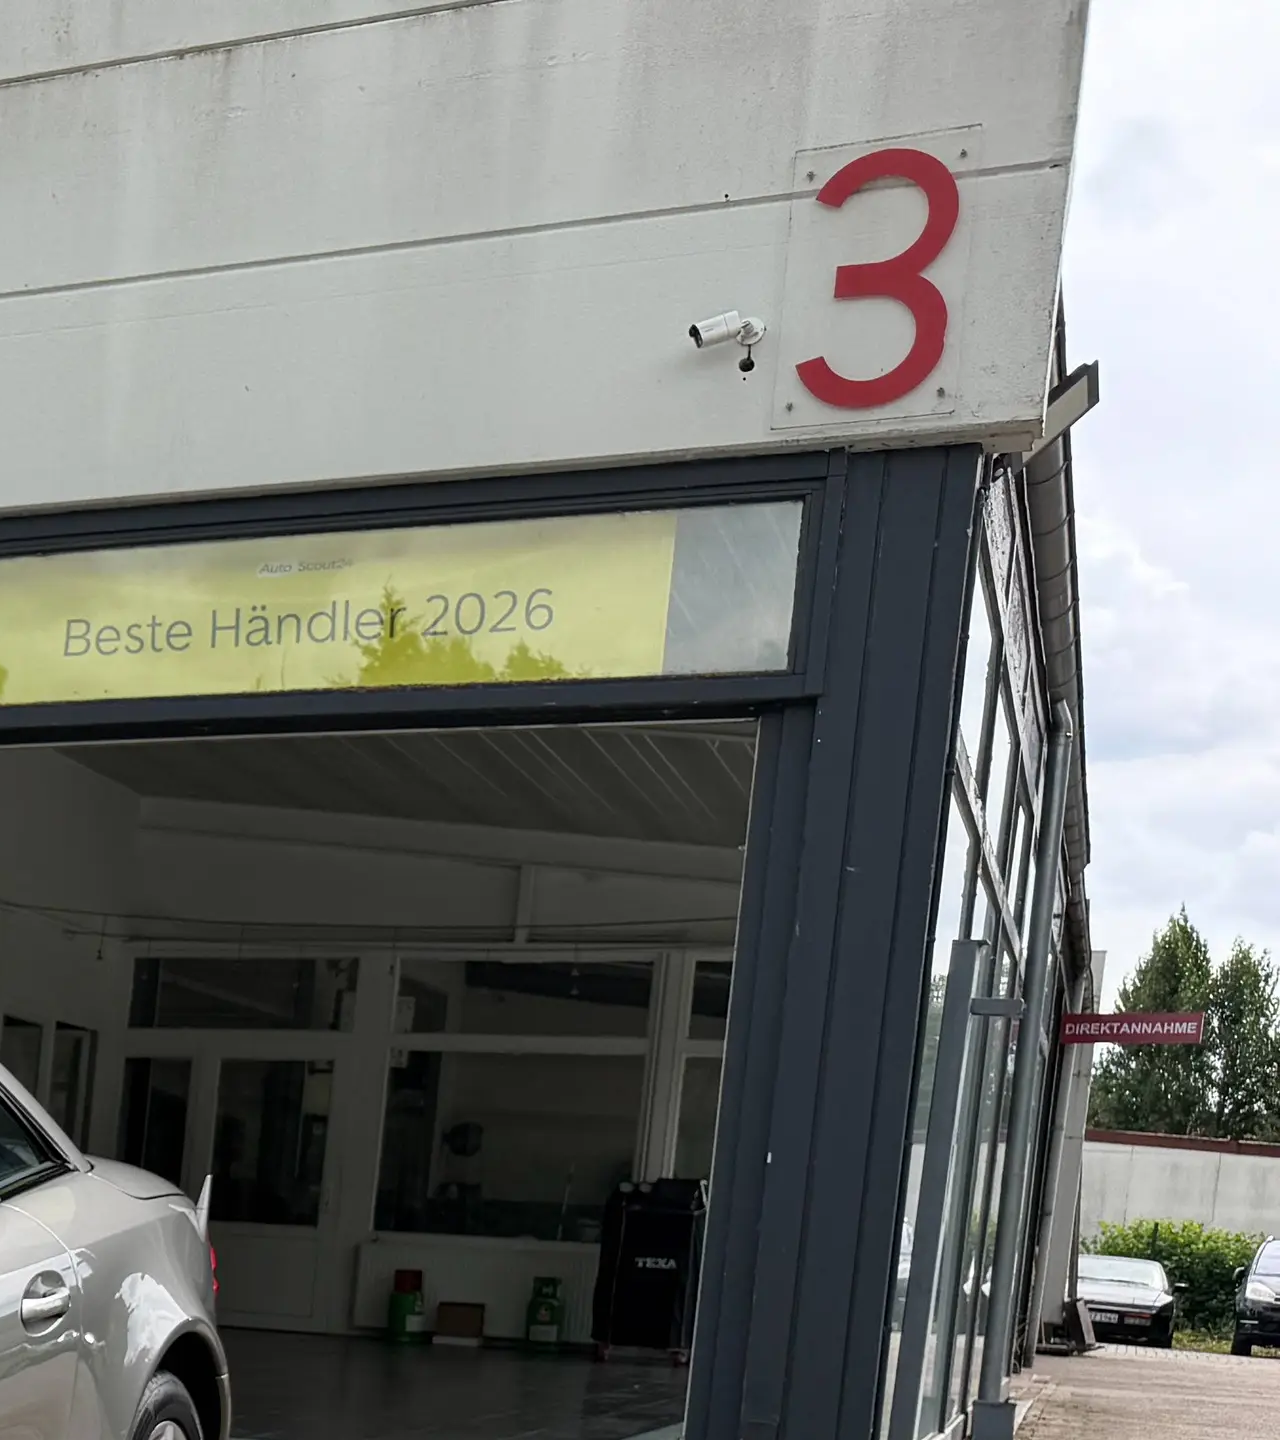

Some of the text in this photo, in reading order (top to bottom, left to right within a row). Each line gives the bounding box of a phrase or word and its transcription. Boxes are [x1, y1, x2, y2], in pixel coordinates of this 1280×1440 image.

[796, 148, 959, 409] 3
[259, 562, 292, 574] Auto
[63, 588, 554, 657] Beste Händler 2026
[1065, 1022, 1197, 1035] DIREKTANNAHME
[635, 1257, 677, 1270] TEXA
